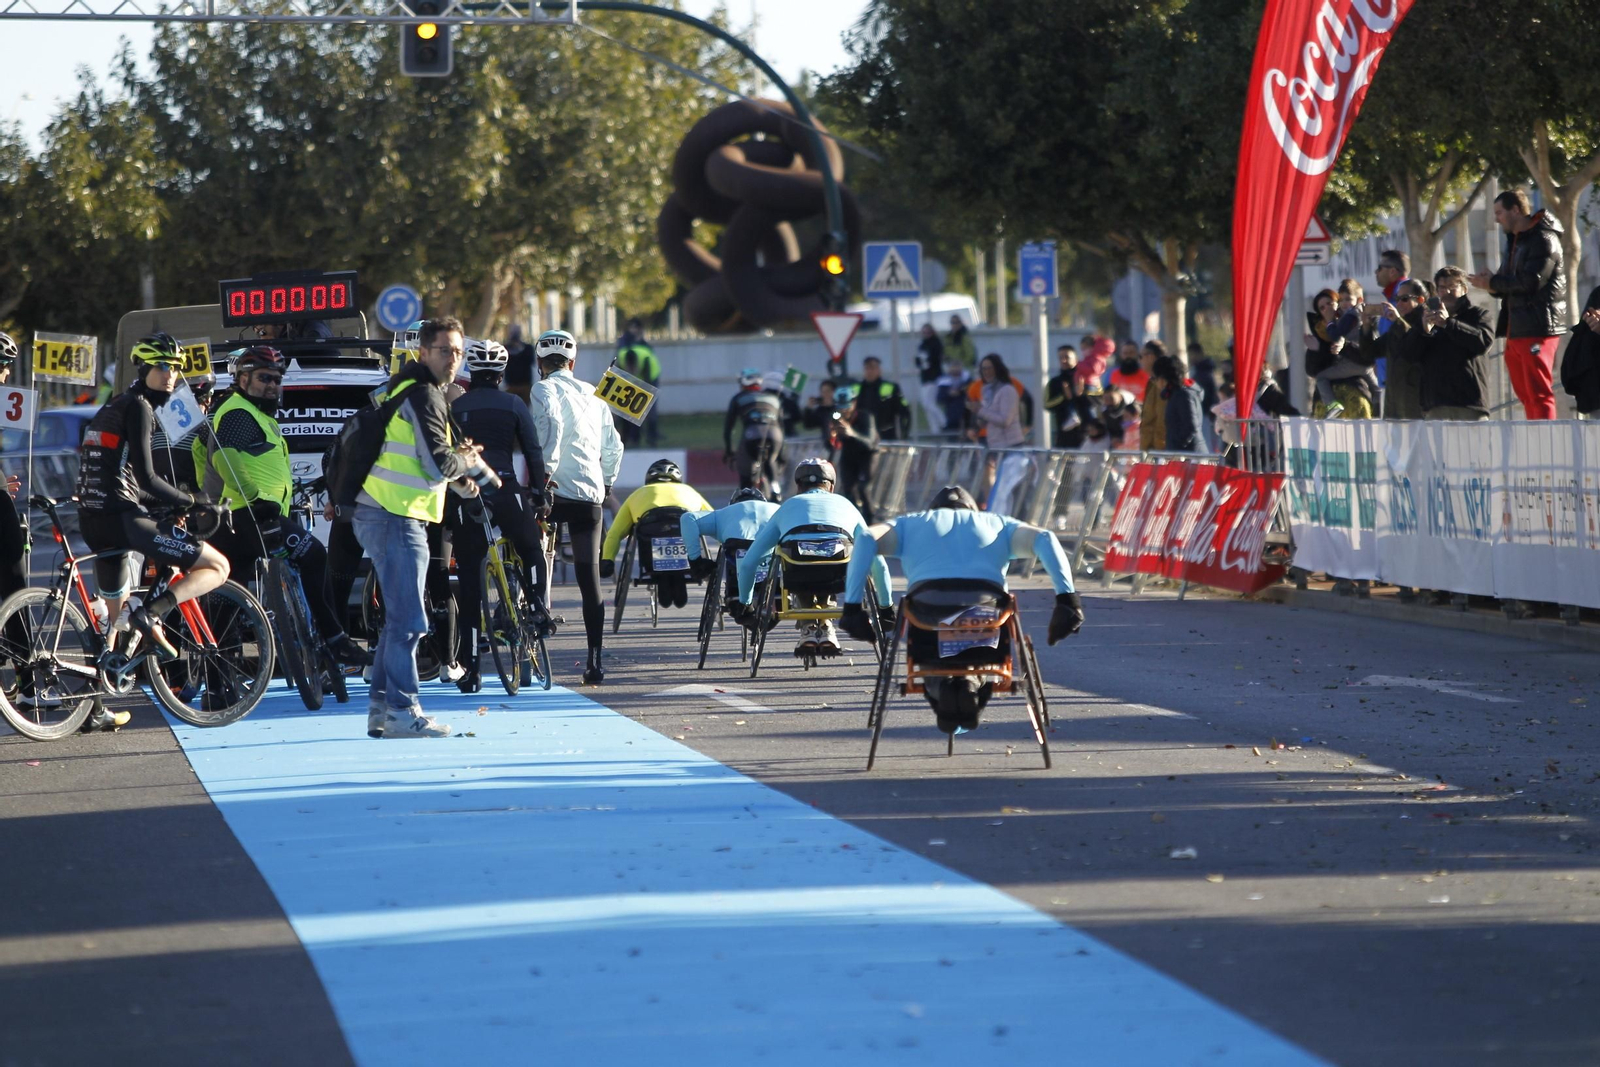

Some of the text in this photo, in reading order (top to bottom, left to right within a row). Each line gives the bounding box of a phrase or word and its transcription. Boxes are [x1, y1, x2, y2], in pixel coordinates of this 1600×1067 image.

[36, 343, 90, 374] 1:40
[5, 391, 24, 421] 3
[600, 375, 649, 415] 1:30
[170, 398, 192, 428] 3
[281, 425, 334, 434] erialva
[153, 534, 197, 555] BIKESTORE
